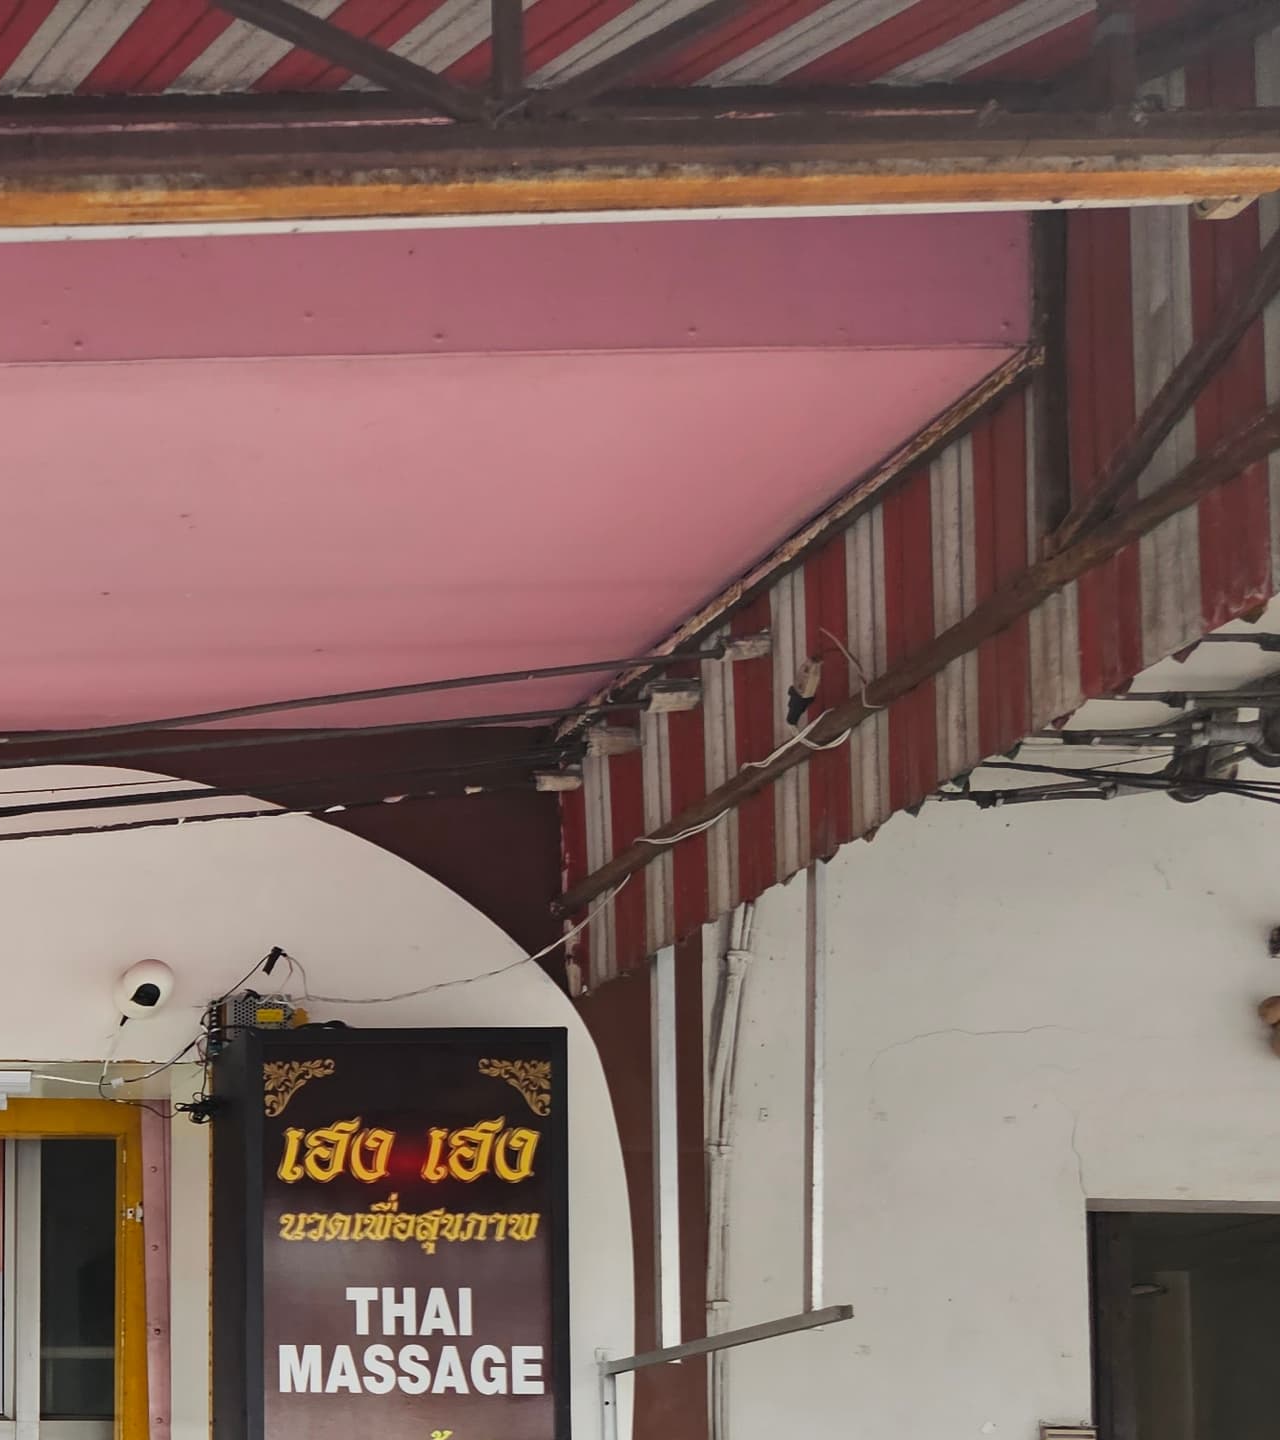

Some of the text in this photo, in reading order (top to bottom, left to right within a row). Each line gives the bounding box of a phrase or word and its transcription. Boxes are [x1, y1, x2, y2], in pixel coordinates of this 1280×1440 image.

[277, 1116, 541, 1184] เฮง เฮง
[279, 1192, 540, 1255] นวดเพื่อสุขภาพ
[345, 1287, 473, 1336] THAI
[278, 1344, 545, 1395] MASSAGE
